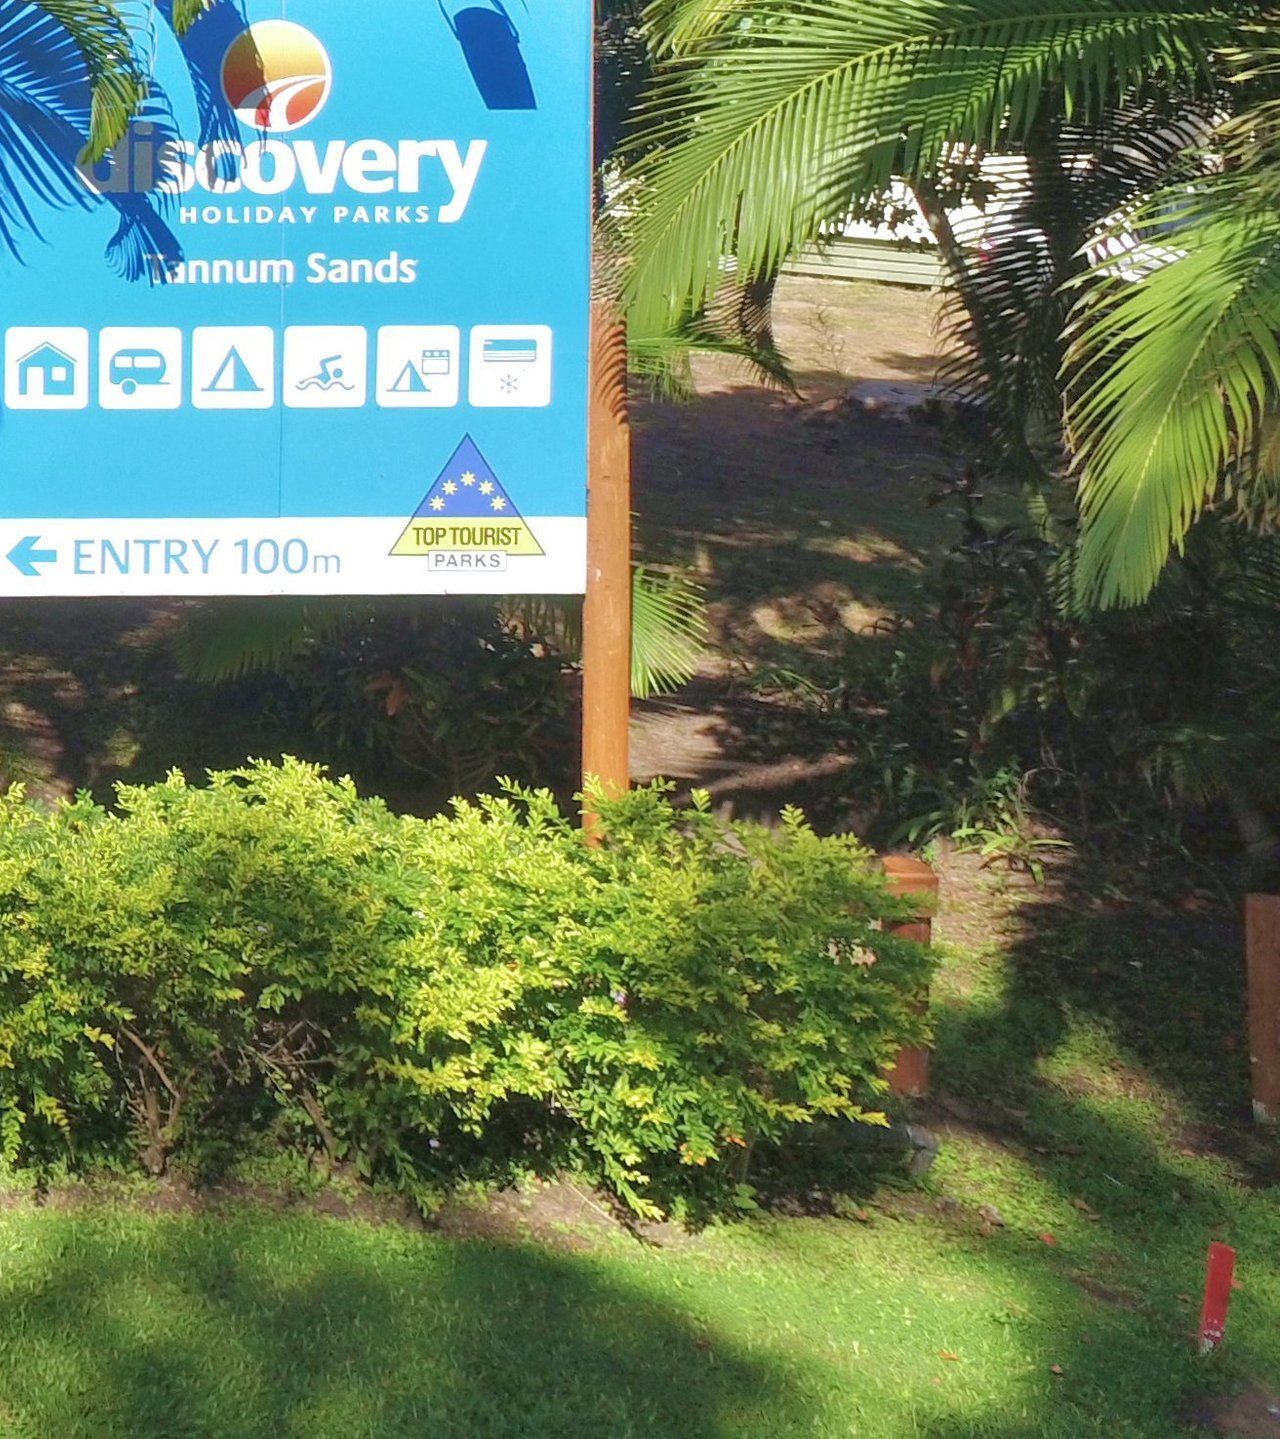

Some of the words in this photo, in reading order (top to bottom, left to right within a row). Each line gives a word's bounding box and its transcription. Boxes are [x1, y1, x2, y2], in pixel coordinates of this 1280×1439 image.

[74, 121, 488, 223] discovery
[180, 206, 318, 224] HOLIDAY
[334, 205, 429, 224] PARKS
[306, 250, 418, 284] Sands
[413, 527, 447, 545] TOP
[449, 527, 522, 545] TOURIST
[74, 539, 219, 574] ENTRY
[434, 554, 501, 567] PARKS
